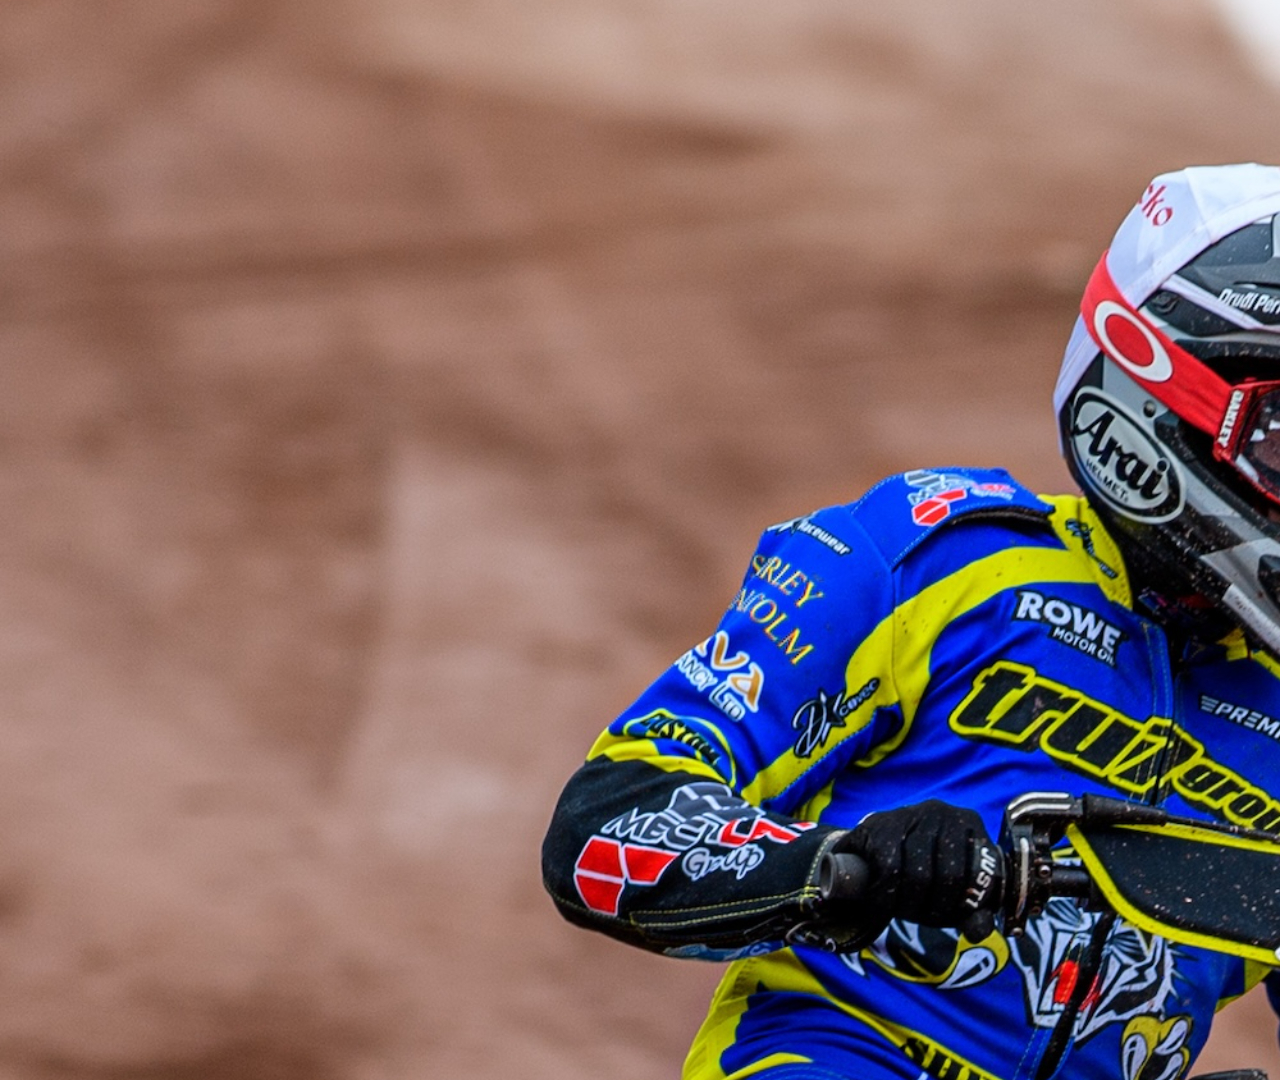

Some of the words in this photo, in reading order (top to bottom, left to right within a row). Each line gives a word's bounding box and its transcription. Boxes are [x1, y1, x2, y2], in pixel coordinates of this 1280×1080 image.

[1137, 183, 1174, 227] ko
[1219, 287, 1254, 309] Drudi
[1217, 389, 1245, 448] OAKLEY
[1071, 409, 1165, 500] Arai
[1086, 457, 1129, 500] HELMET
[1014, 591, 1122, 653] ROWE
[1053, 625, 1100, 661] MOTOR
